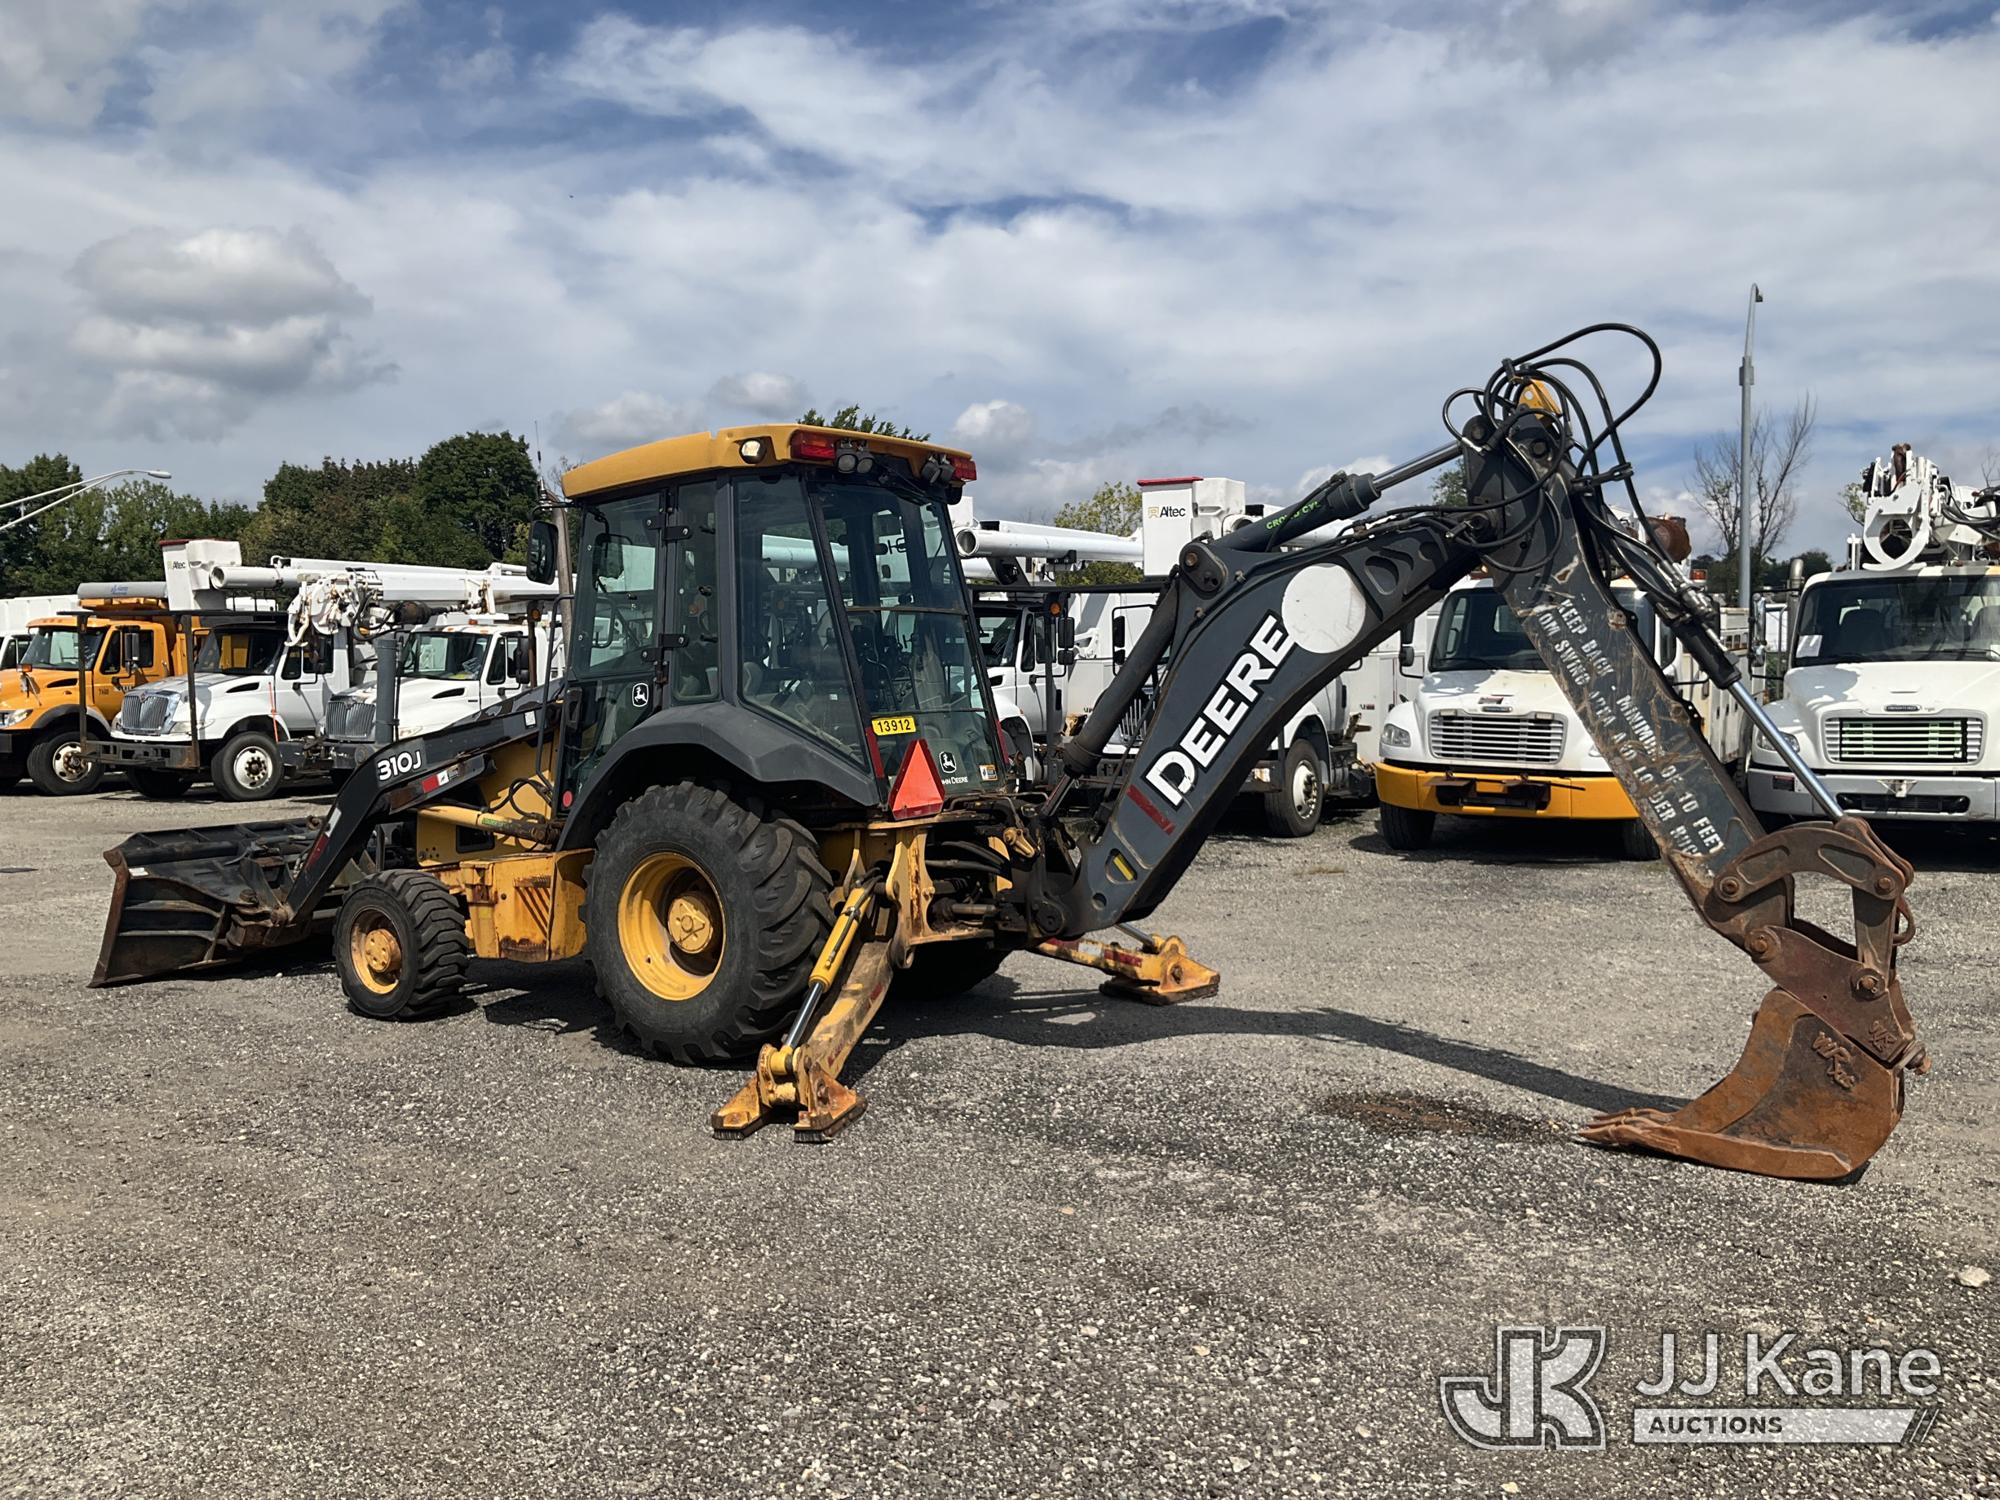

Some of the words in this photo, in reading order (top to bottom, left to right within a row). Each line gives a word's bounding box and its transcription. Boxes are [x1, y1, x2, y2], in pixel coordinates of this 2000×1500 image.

[1160, 506, 1186, 517] Altec
[1554, 639, 1590, 685] SWING
[1146, 614, 1296, 806] DEERE
[1558, 599, 1587, 634] KEEP
[1581, 639, 1614, 677] BACK
[1678, 792, 1699, 813] 10
[877, 719, 911, 733] 13912
[377, 751, 422, 780] 310J
